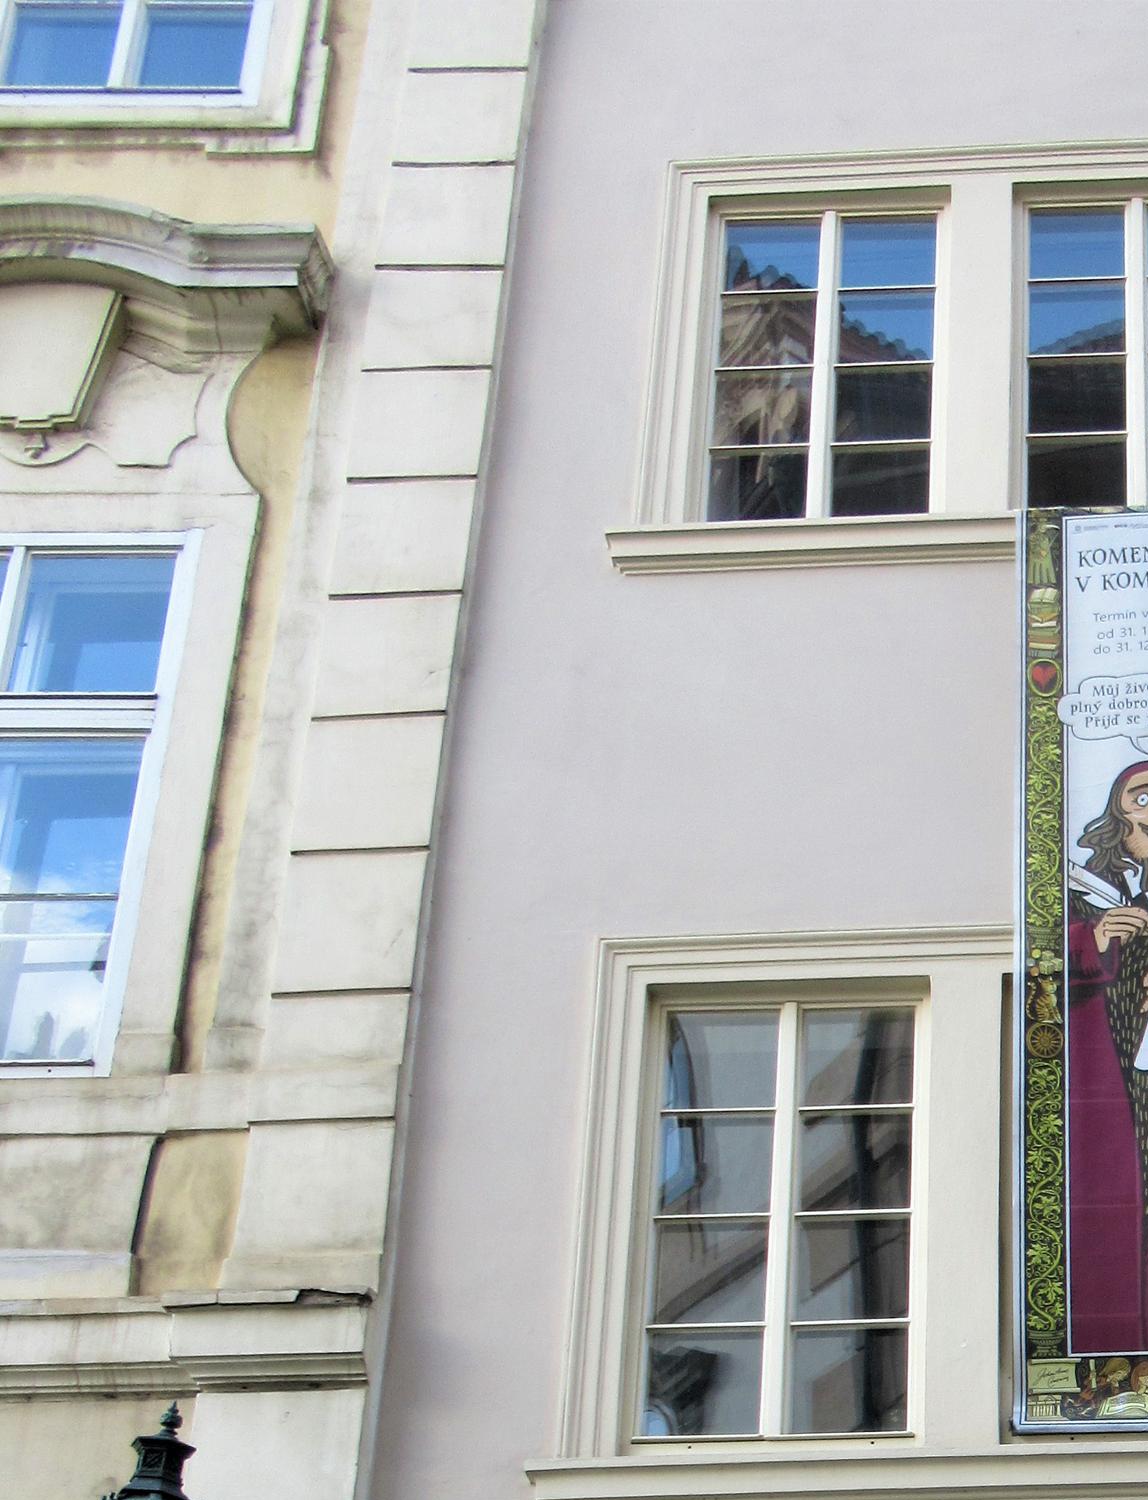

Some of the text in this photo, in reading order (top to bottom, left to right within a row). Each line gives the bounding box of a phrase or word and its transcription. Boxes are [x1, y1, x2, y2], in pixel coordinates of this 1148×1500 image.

[1075, 575, 1092, 593] V
[1093, 610, 1137, 623] Termín
[1097, 629, 1114, 640] od
[1119, 626, 1137, 638] 31.
[1093, 644, 1111, 655] do
[1116, 641, 1134, 653] 31.
[1092, 683, 1120, 698] Můj
[1071, 700, 1102, 716] plný
[1126, 714, 1141, 725] se
